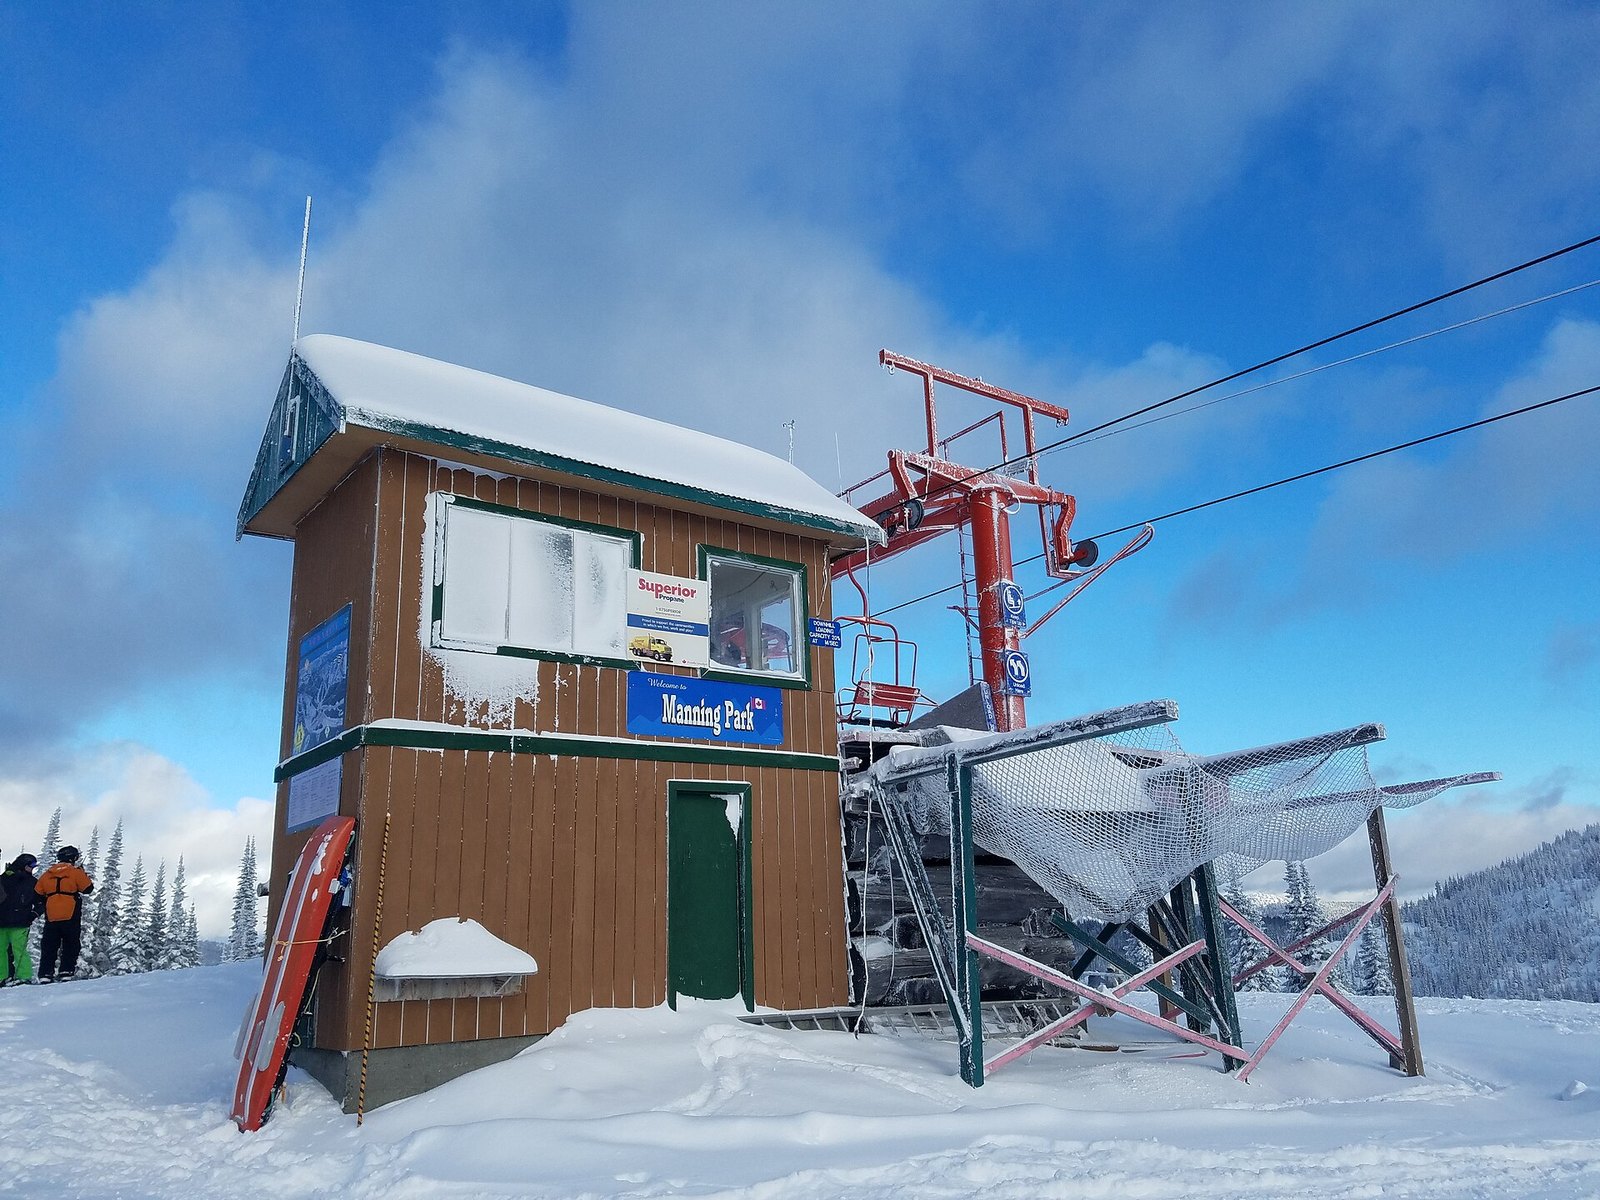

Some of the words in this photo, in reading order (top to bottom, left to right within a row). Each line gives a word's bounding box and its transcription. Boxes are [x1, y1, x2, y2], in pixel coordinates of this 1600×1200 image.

[638, 578, 696, 598] Superior
[659, 594, 685, 603] Propane
[813, 620, 835, 628] DOWNHILL
[647, 678, 679, 689] Welcome
[662, 694, 721, 736] Manning
[724, 700, 754, 731] Park
